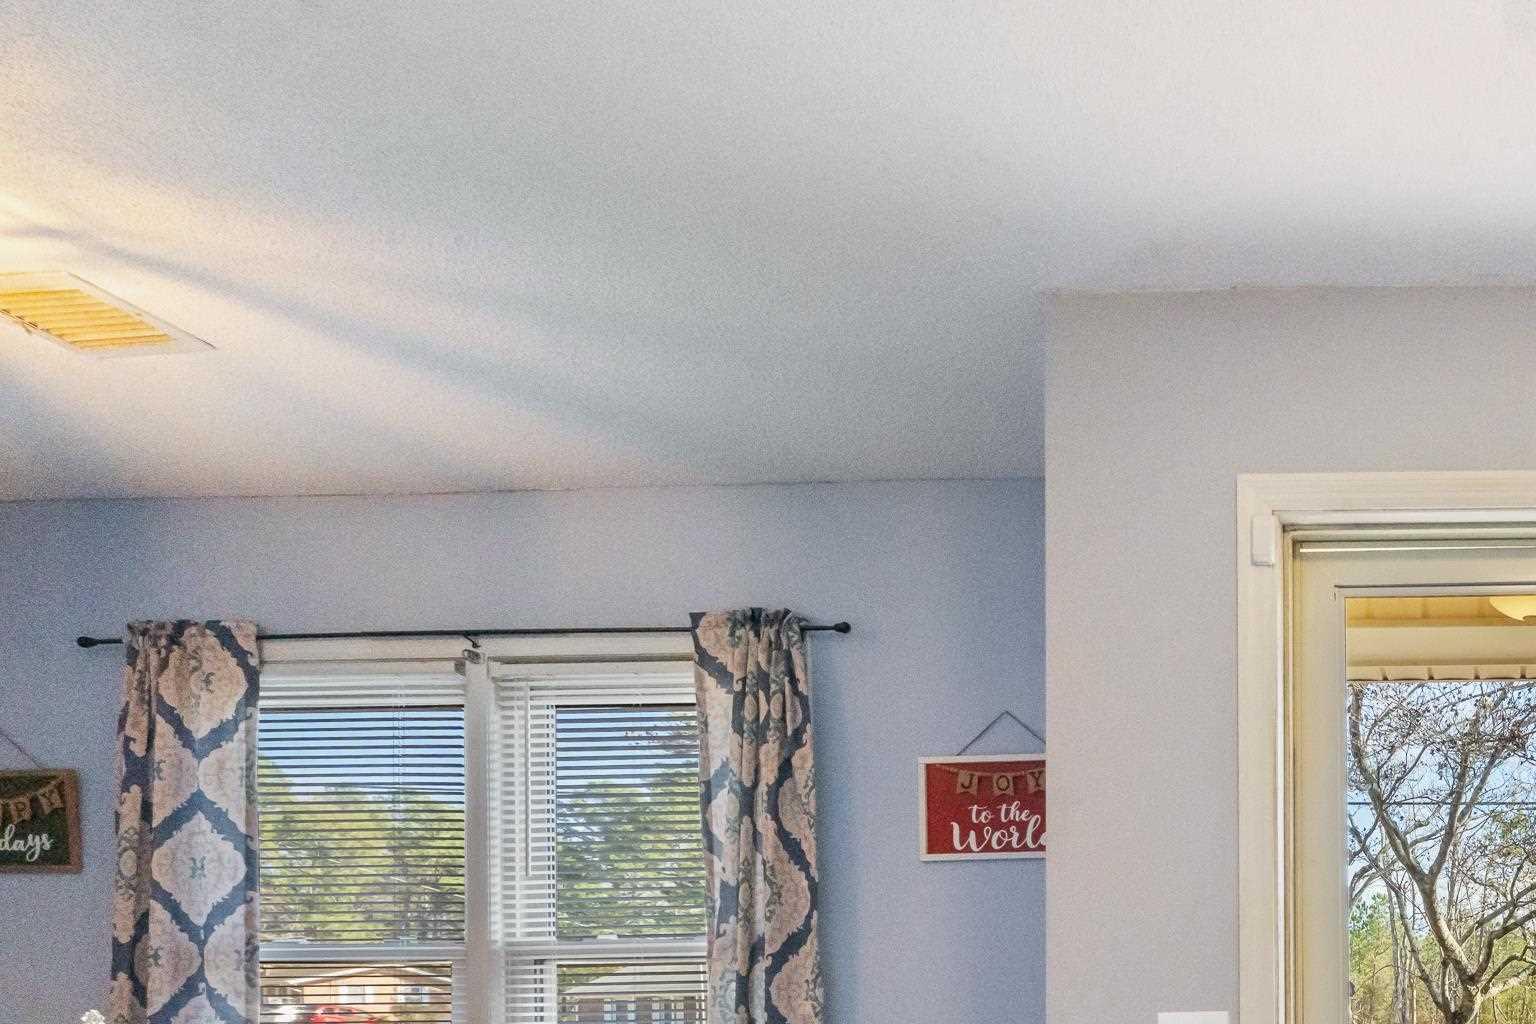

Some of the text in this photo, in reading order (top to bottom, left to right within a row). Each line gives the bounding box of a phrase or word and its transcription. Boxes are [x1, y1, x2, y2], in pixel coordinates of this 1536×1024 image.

[960, 770, 1045, 791] JOY
[968, 800, 1032, 823] to the
